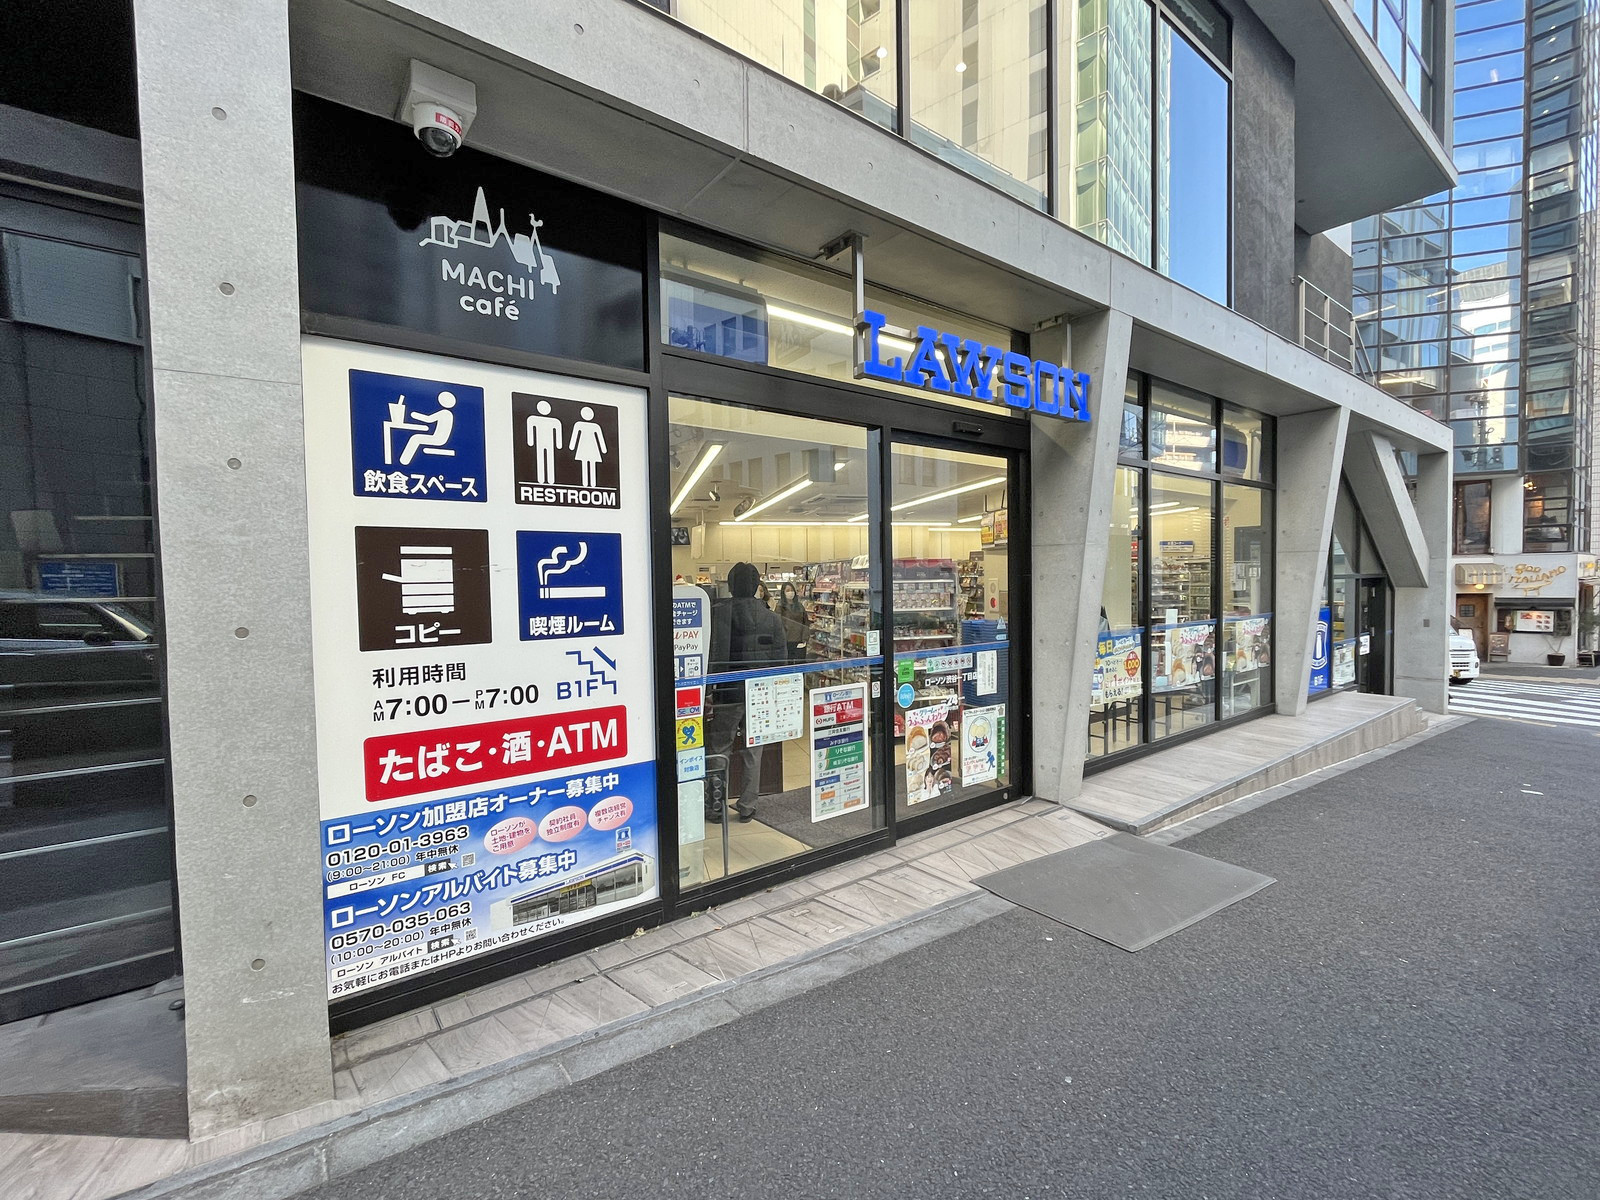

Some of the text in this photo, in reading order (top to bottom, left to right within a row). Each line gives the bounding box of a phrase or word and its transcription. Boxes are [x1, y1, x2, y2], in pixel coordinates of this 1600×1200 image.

[441, 258, 534, 300] MACHI
[459, 295, 520, 321] café
[863, 309, 1091, 422] LAWSON
[364, 470, 479, 497] 飲食スペース
[520, 487, 617, 507] RESTROOM
[395, 622, 462, 645] コピー
[529, 613, 616, 638] 喫煙ルーム
[682, 631, 699, 639] PAY
[674, 643, 699, 652] PayPay
[372, 662, 467, 689] 利用時間
[556, 678, 599, 700] B1F
[823, 700, 854, 714] 銀行ATM
[379, 718, 618, 785] たばこ・酒・ATM
[327, 772, 619, 846] ローソン加盟店オーナー募集中
[548, 812, 577, 827] 契約社員
[490, 820, 526, 837] ローソンが
[546, 819, 580, 836] 独立制度有
[327, 826, 469, 867] 0120-01-3963
[415, 844, 459, 862] 年中無休
[492, 840, 515, 853] ご用意
[349, 861, 448, 891] ローソン FC 検索
[331, 850, 578, 929] ローソンアルバイト募集中
[331, 901, 471, 950] 0570-035-063
[429, 917, 472, 937] 年中無休
[337, 960, 374, 978] ローソン
[380, 946, 423, 965] アルバイト
